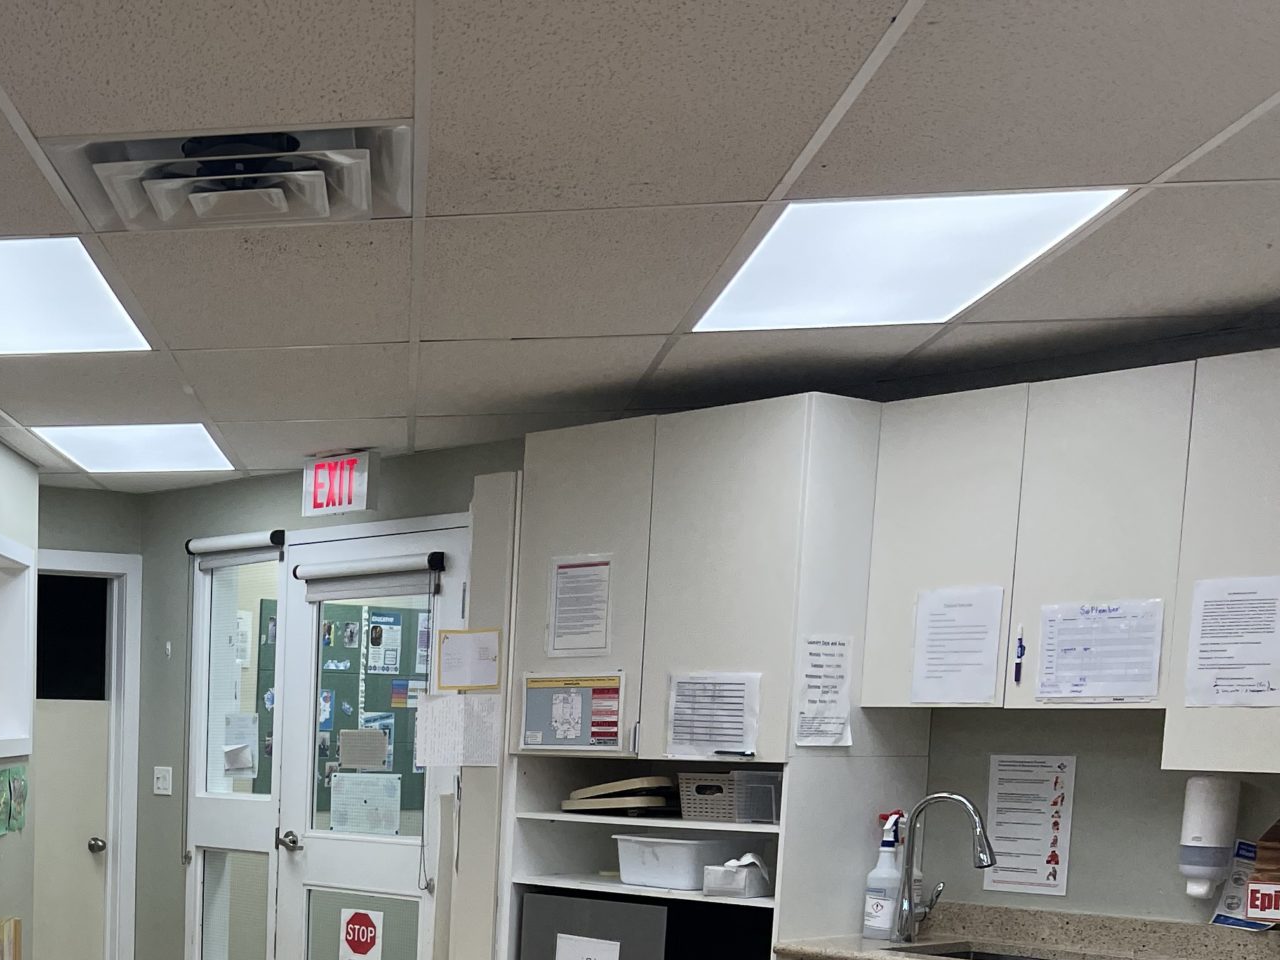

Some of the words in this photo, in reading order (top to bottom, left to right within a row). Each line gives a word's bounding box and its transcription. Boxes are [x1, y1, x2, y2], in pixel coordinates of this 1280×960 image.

[313, 458, 358, 508] EXIT
[1249, 889, 1280, 911] Epi
[347, 924, 375, 943] STOP
